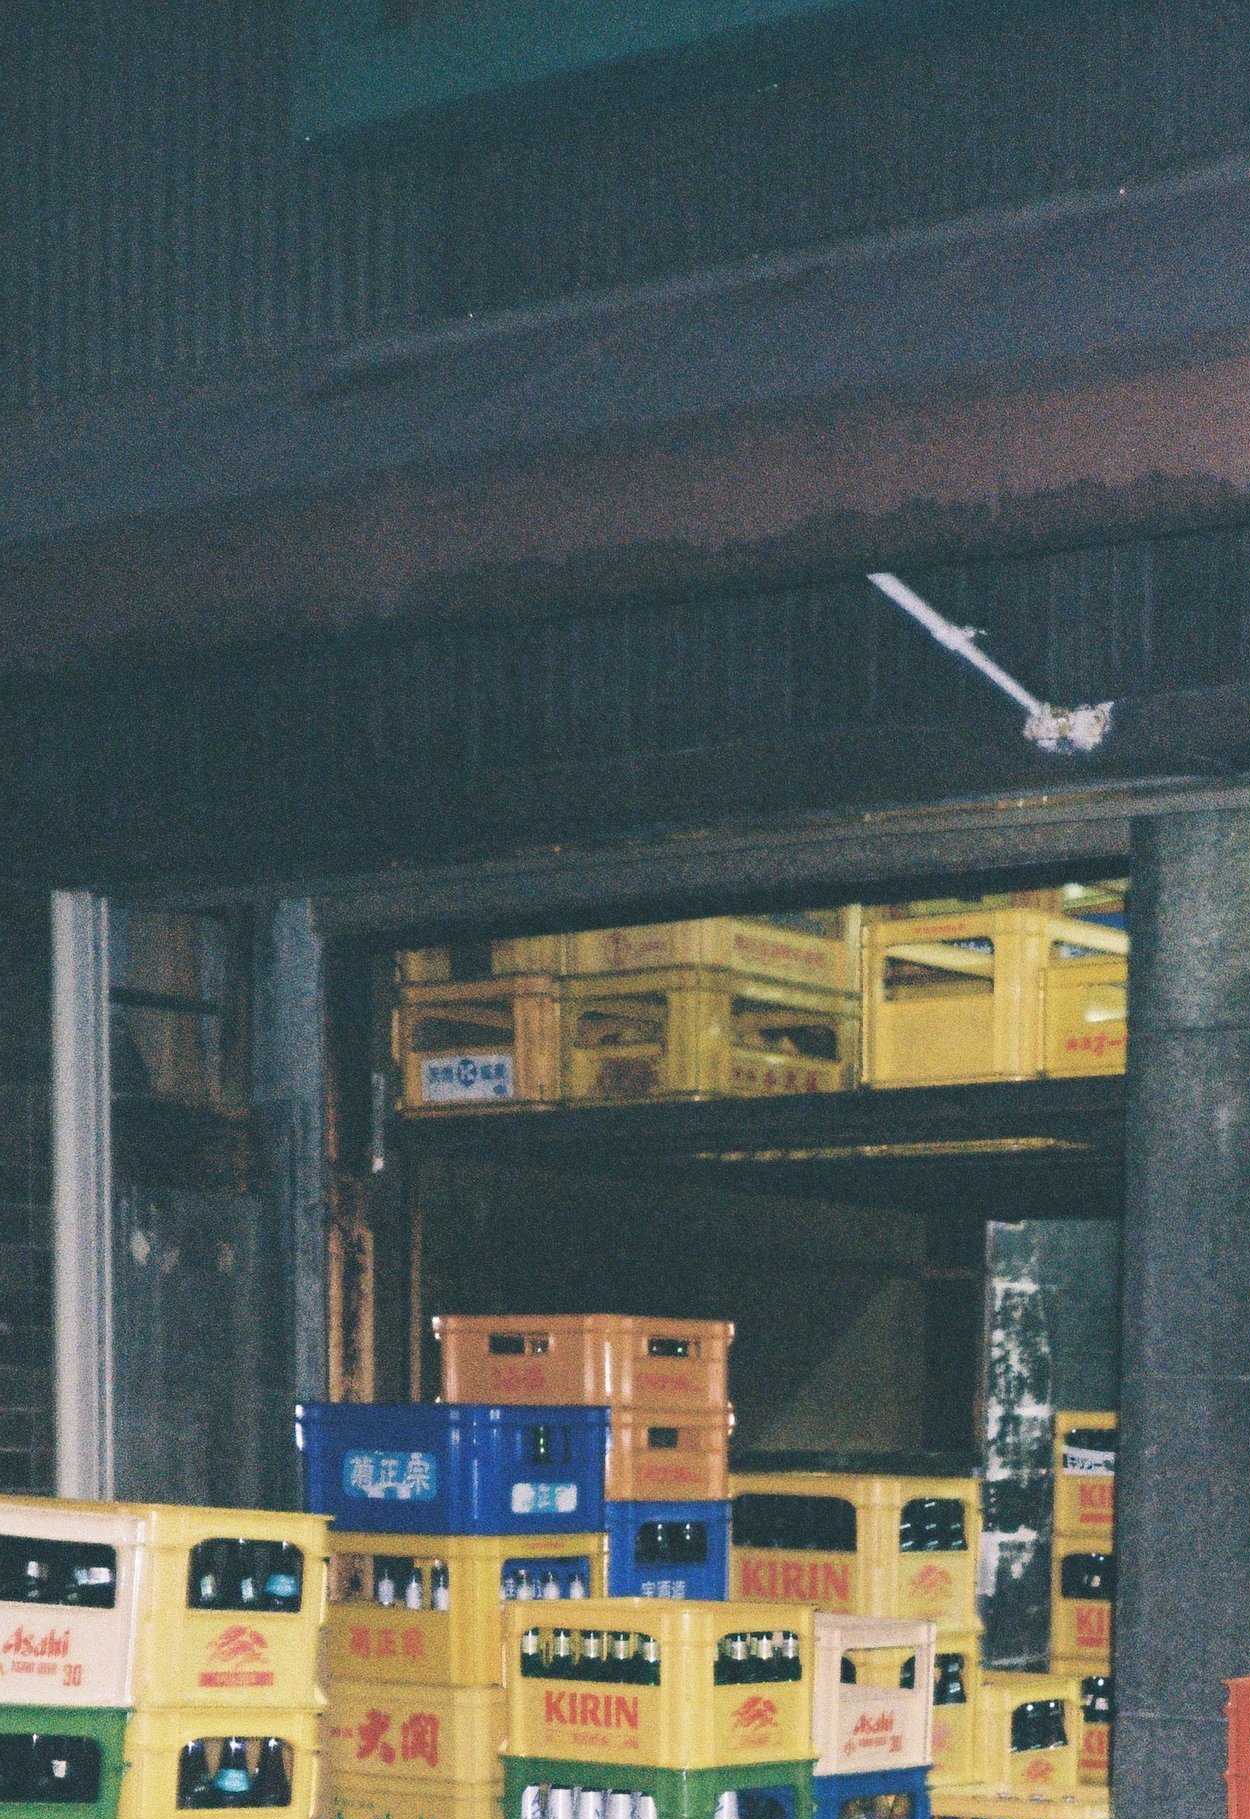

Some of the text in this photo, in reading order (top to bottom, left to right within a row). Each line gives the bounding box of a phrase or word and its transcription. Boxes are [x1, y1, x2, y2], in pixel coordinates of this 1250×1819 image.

[740, 1559, 850, 1602] KIRIN
[2, 1624, 70, 1657] Asahi
[543, 1689, 639, 1731] KIRIN
